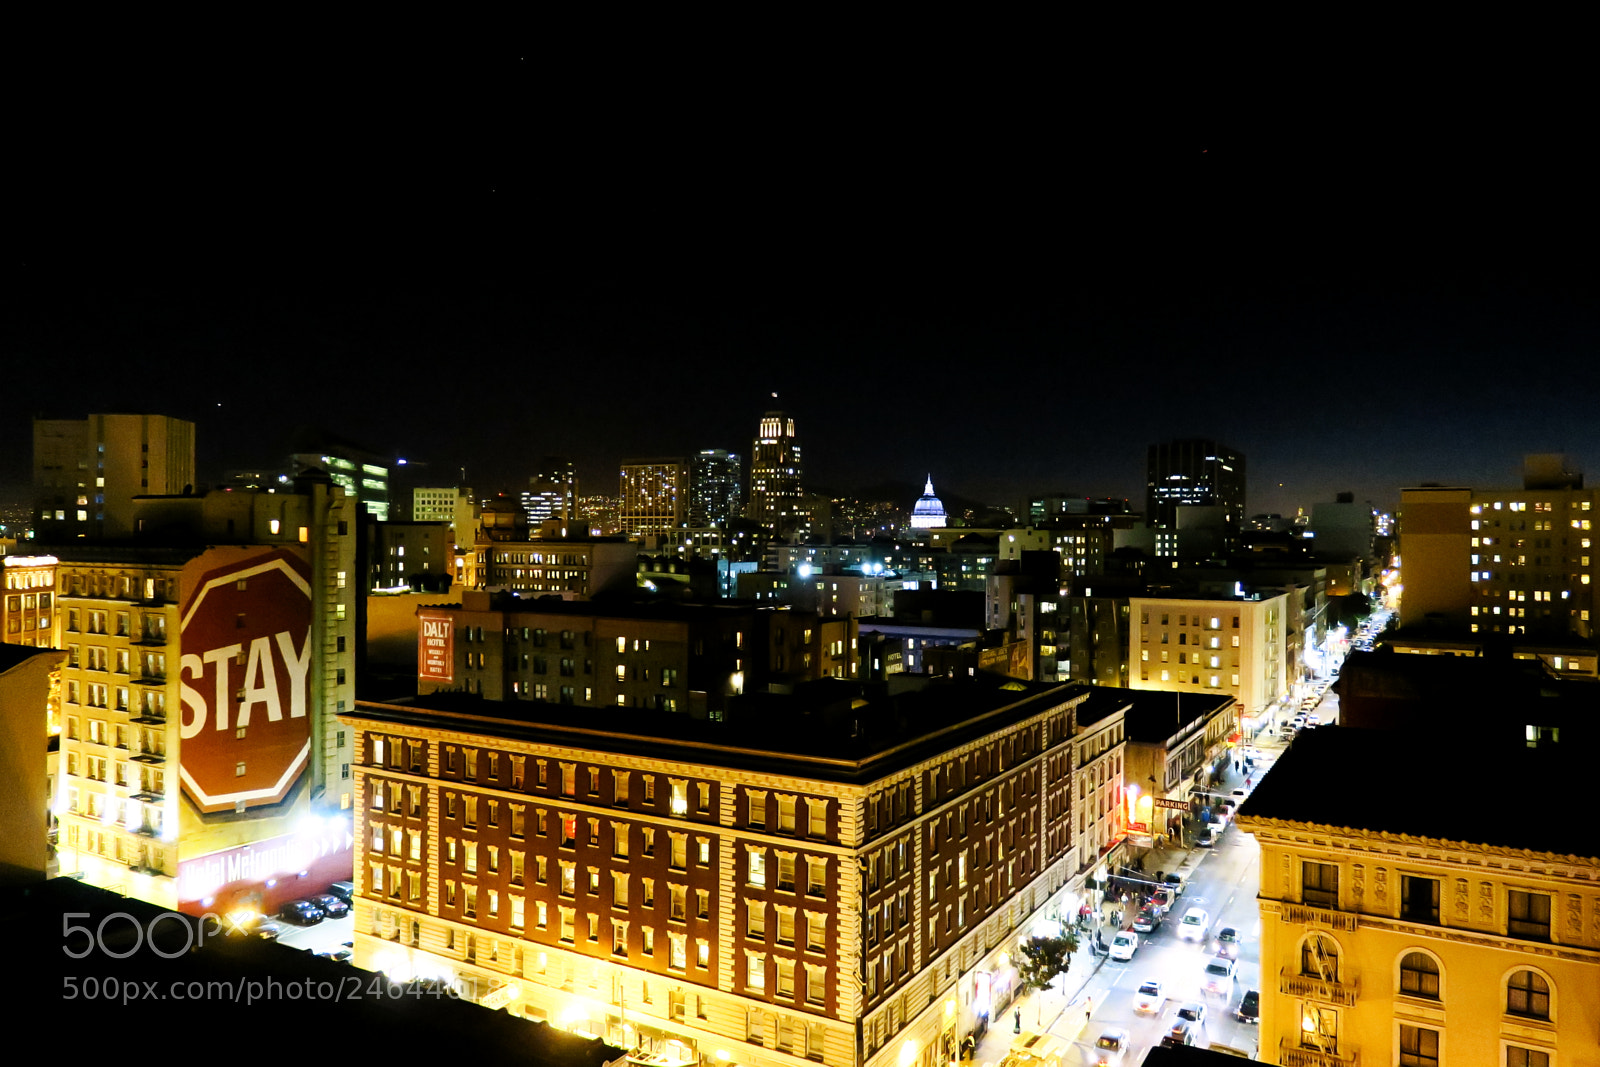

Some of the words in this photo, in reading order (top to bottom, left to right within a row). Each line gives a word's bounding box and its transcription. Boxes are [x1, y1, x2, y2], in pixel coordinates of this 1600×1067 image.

[424, 621, 449, 638] DALT
[427, 638, 446, 647] HOTEL
[887, 652, 902, 661] HOTEL
[180, 624, 312, 739] STAY
[1155, 799, 1188, 810] PARKING
